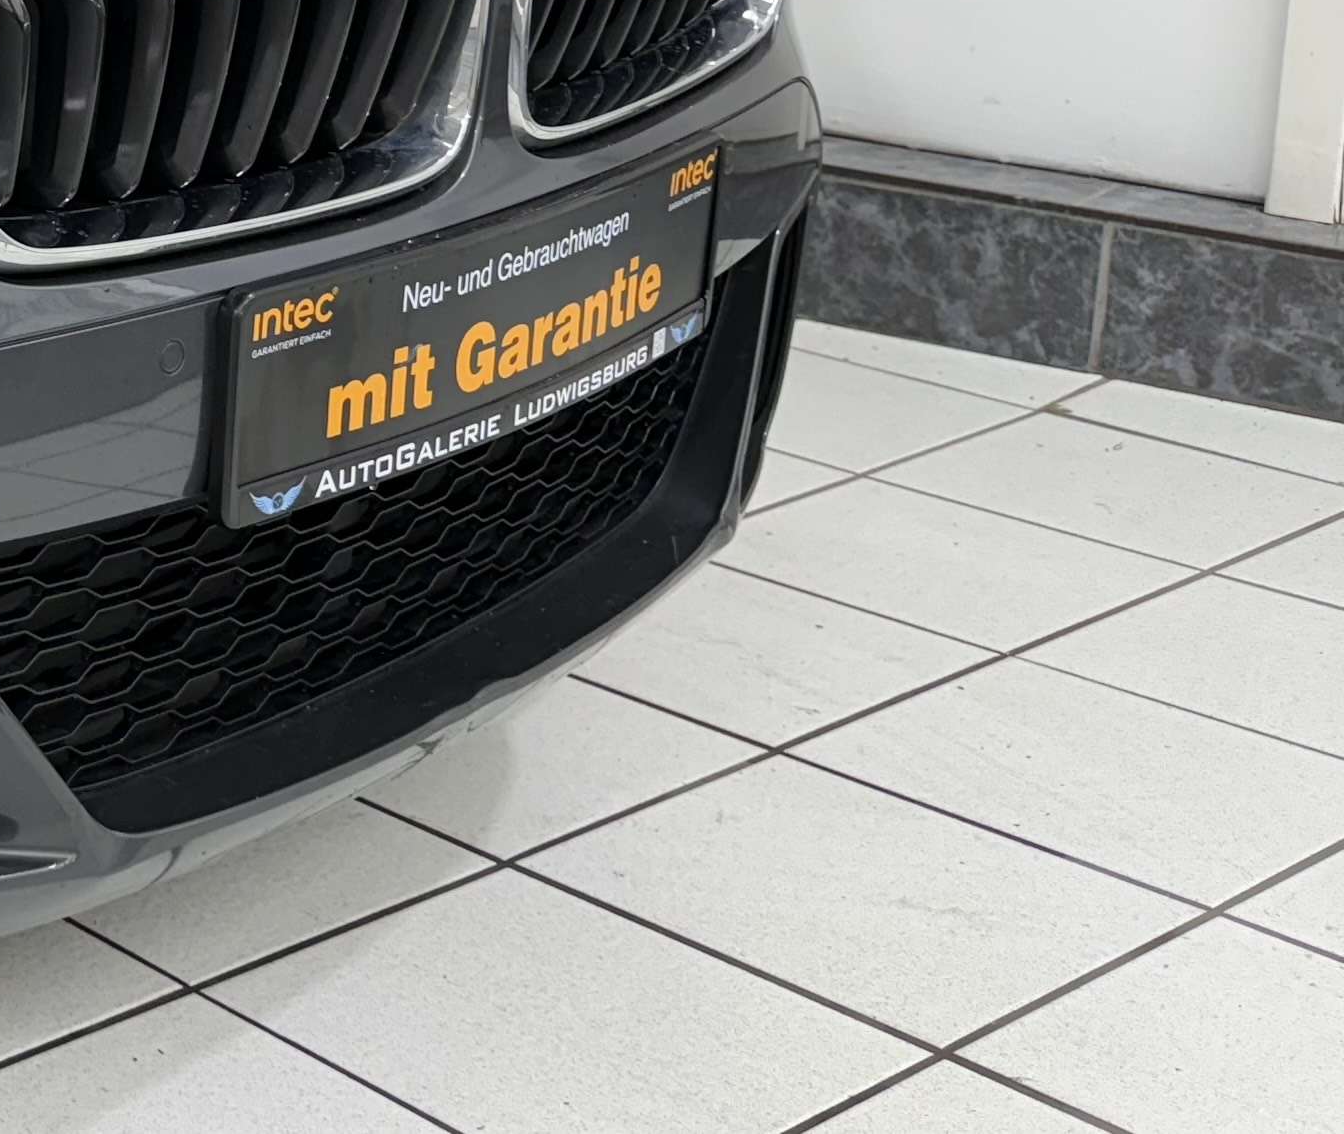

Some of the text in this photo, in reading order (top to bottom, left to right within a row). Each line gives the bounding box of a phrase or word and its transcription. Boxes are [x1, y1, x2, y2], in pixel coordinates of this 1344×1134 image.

[402, 211, 630, 313] Neu- und Gebrauchtwagen
[325, 255, 662, 440] mit Garantie
